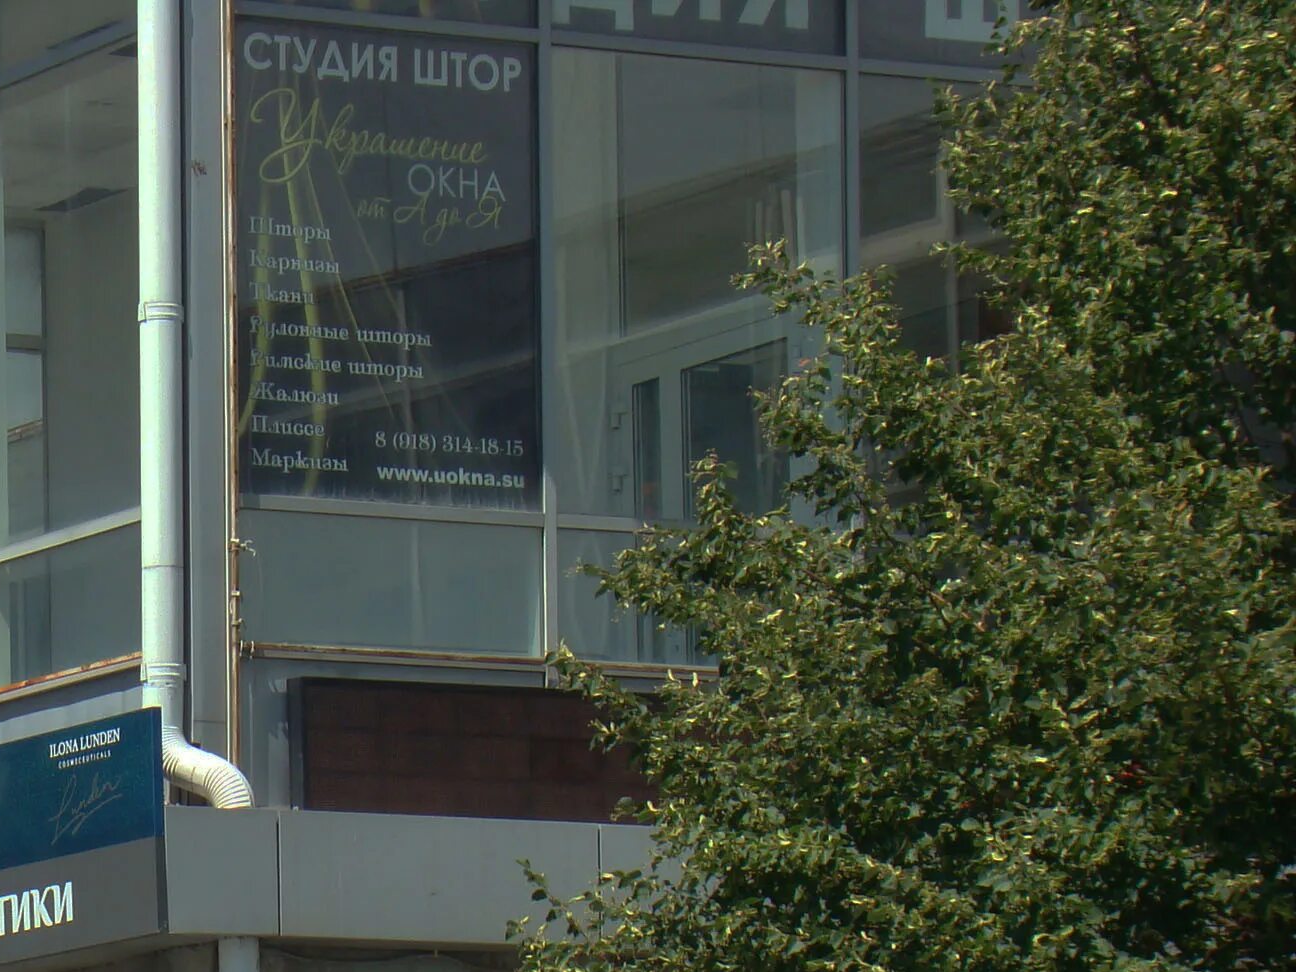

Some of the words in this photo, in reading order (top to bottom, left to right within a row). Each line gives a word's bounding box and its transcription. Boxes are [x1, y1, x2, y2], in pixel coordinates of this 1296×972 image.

[243, 31, 398, 83] СТУДИЯ
[413, 47, 523, 93] ШТОР
[250, 87, 488, 183] Украшение
[407, 163, 506, 202] ОКНА
[357, 196, 392, 218] от
[249, 215, 332, 244] Шторы
[249, 249, 340, 275] Карнизы
[249, 281, 315, 305] Ткани
[250, 314, 349, 340] Рулонные
[356, 327, 433, 350] шторы
[250, 348, 342, 373] Римские
[347, 359, 425, 382] шторы
[252, 381, 339, 406] Жалюзи
[251, 414, 326, 437] Плиссе
[375, 430, 387, 448] 8
[392, 431, 437, 454] (918)
[442, 434, 524, 457] 314-18-15
[251, 447, 349, 474] Маркизы
[376, 464, 526, 489] www.uokna.su
[48, 738, 79, 758] ILONA
[79, 727, 121, 751] LUNDEN
